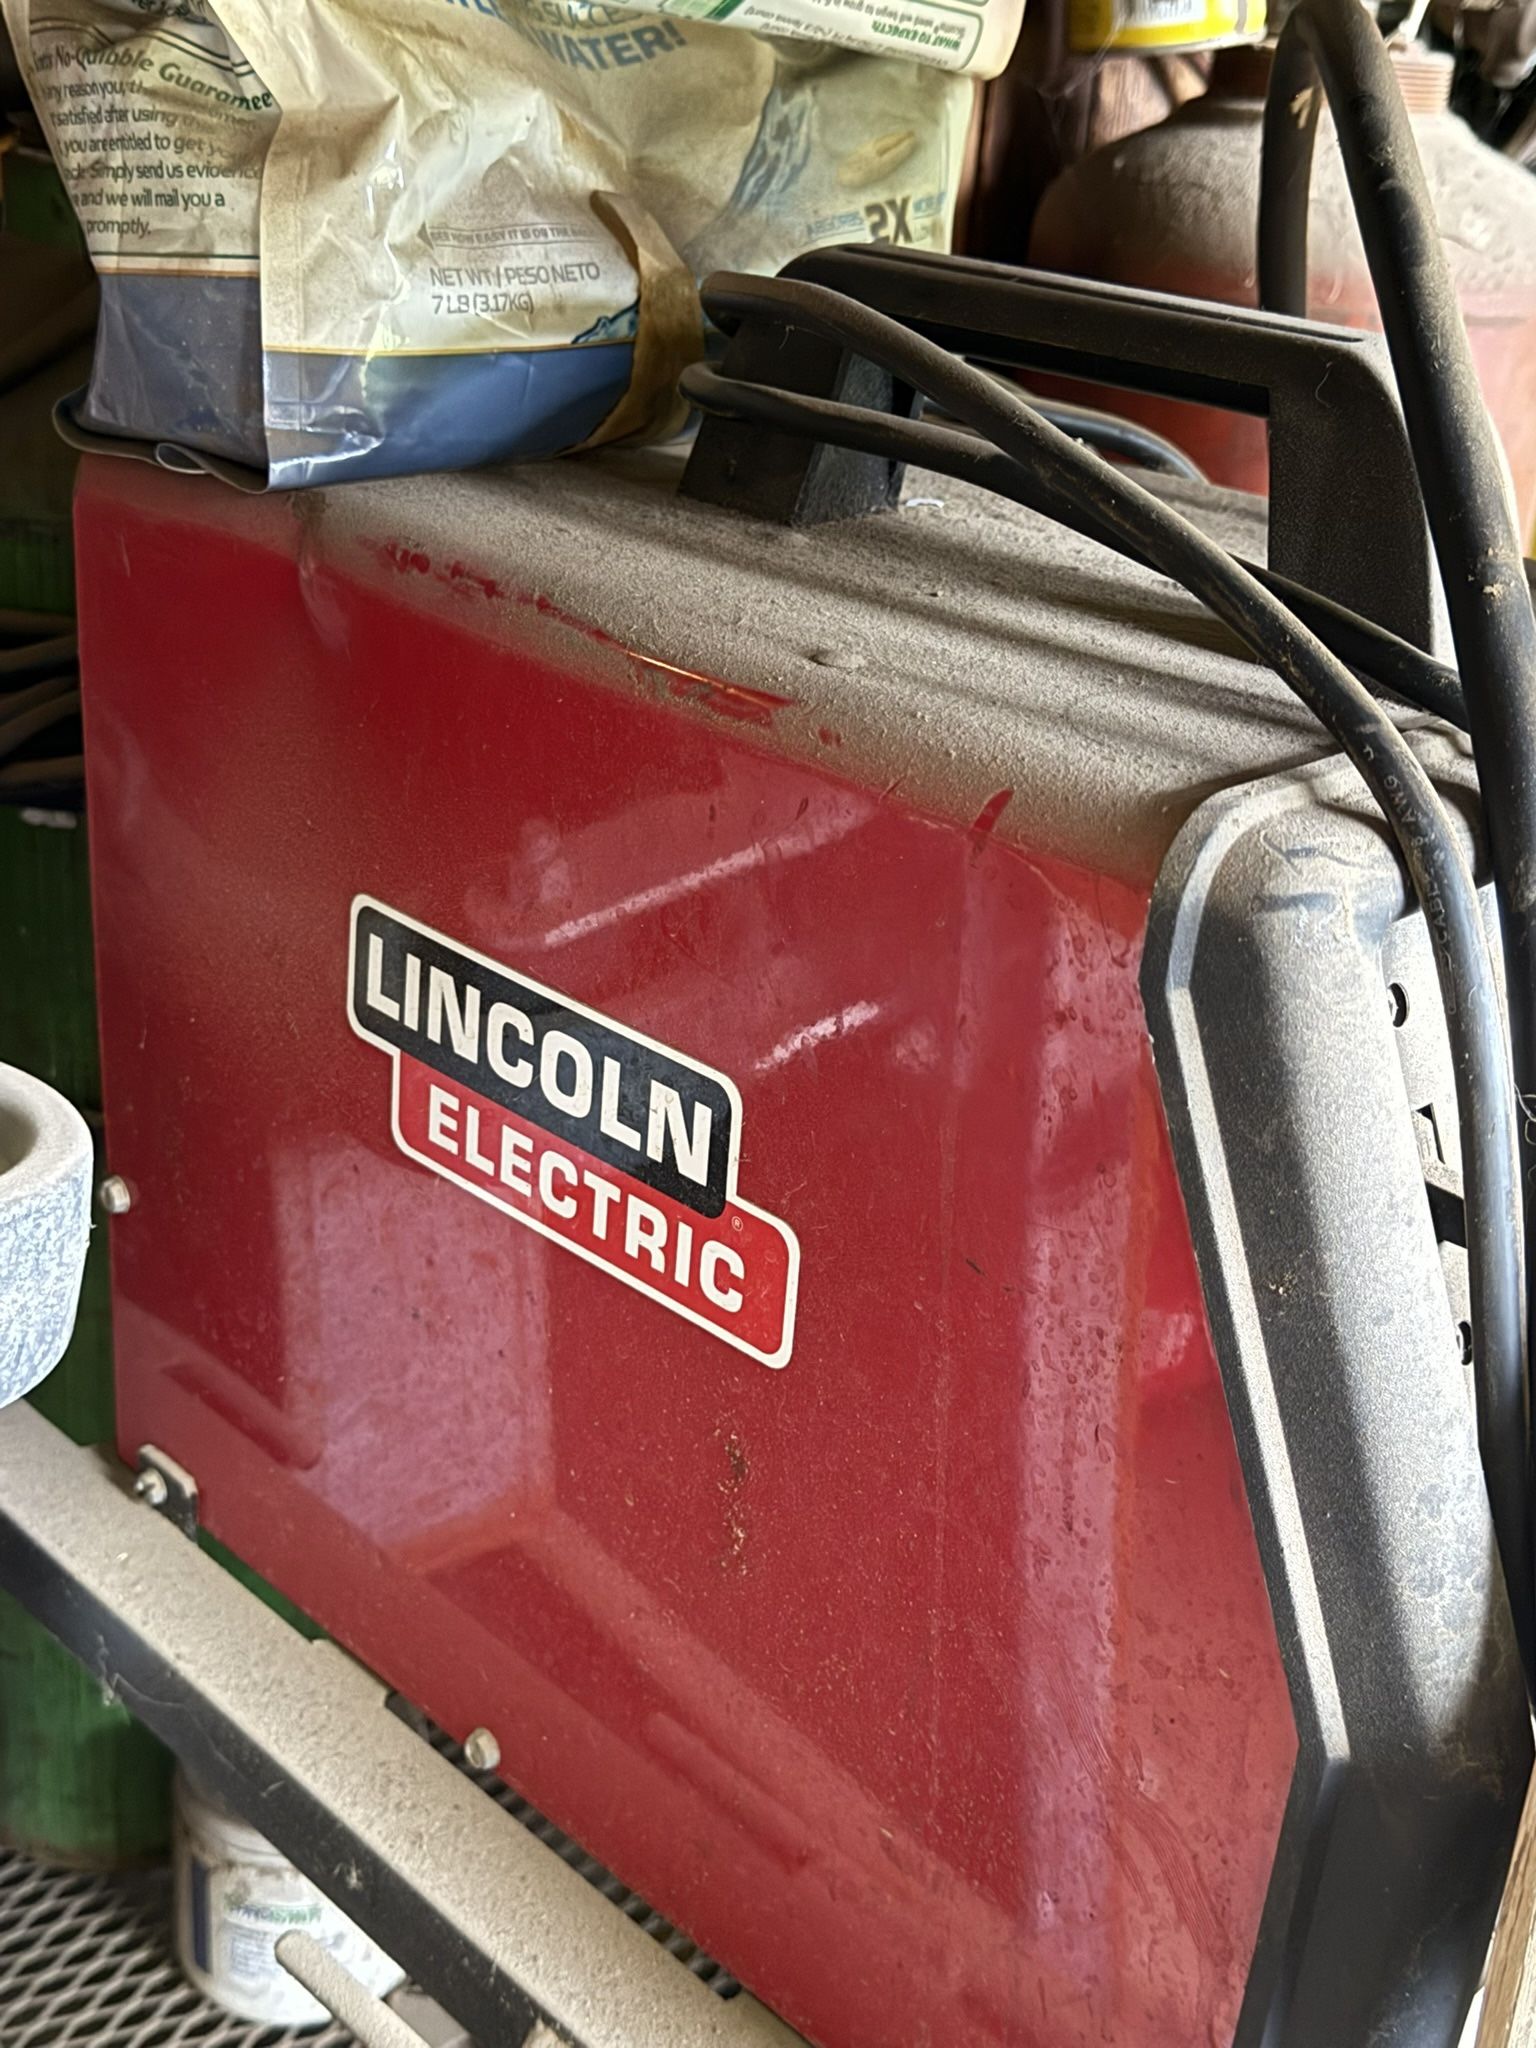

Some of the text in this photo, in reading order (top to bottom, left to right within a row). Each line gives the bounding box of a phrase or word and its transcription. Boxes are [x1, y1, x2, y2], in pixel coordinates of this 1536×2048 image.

[531, 20, 687, 71] WATER!
[154, 133, 171, 150] to
[136, 162, 165, 179] send
[166, 164, 184, 179] us
[81, 189, 103, 208] and
[105, 192, 128, 207] we
[131, 187, 151, 207] will
[180, 192, 212, 213] you
[214, 192, 226, 207] a
[86, 216, 151, 239] promptly.
[864, 195, 914, 244] 2X
[475, 230, 506, 245] EASY
[507, 229, 518, 241] IT
[430, 267, 463, 287] NET
[503, 266, 551, 286] PESO
[552, 261, 600, 283] NETO
[431, 295, 444, 315] 7
[447, 294, 470, 314] LB
[366, 932, 713, 1187] LINCOLN
[428, 1084, 745, 1313] ELECTRIC
